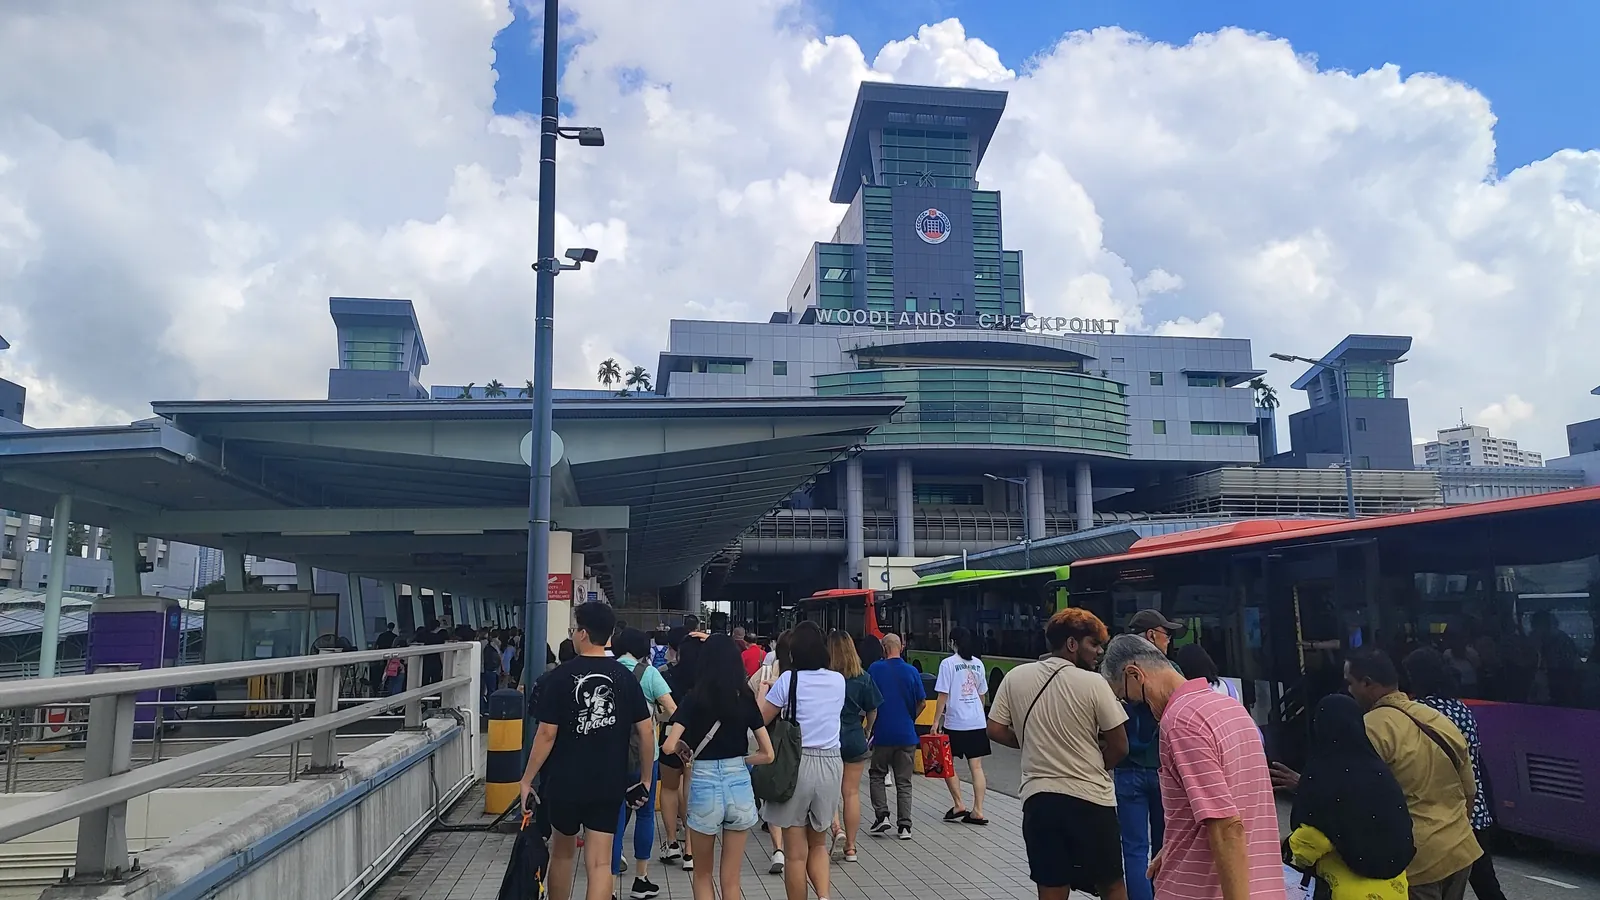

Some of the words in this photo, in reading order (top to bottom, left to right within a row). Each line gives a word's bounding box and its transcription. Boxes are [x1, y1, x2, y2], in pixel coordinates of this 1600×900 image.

[815, 308, 957, 328] WOODLANDS
[978, 312, 1120, 334] CHECKPOINT
[576, 715, 616, 735] Space
